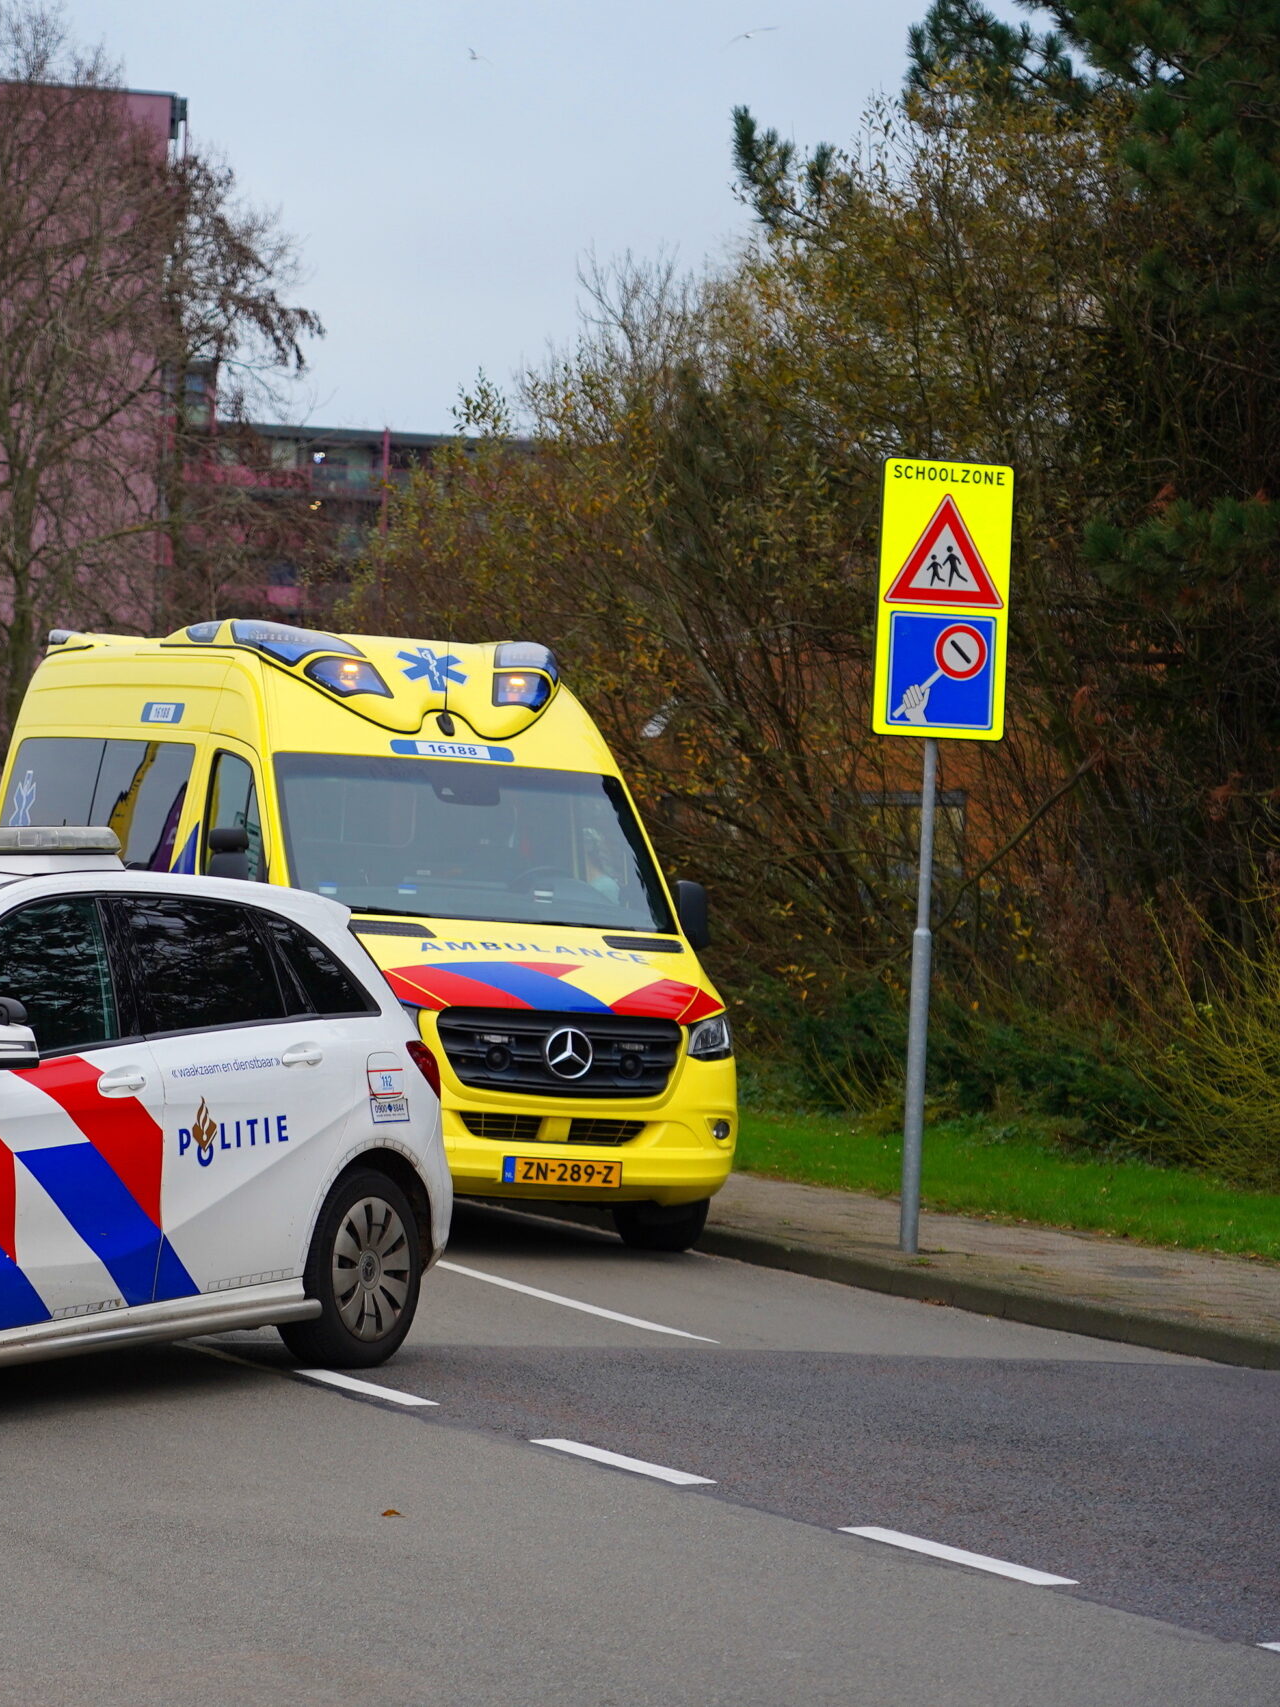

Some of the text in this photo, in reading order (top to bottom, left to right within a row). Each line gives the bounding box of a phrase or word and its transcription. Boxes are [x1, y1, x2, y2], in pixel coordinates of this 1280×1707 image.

[893, 464, 1006, 487] SCHOOLZONE
[428, 744, 478, 756] 16188
[420, 940, 650, 965] AMBULANCE
[222, 1061, 234, 1073] en
[232, 1055, 274, 1071] dienstbaar
[381, 1075, 392, 1087] 112
[178, 1115, 289, 1167] POLITIE
[522, 1161, 614, 1184] ZN-289-Z
